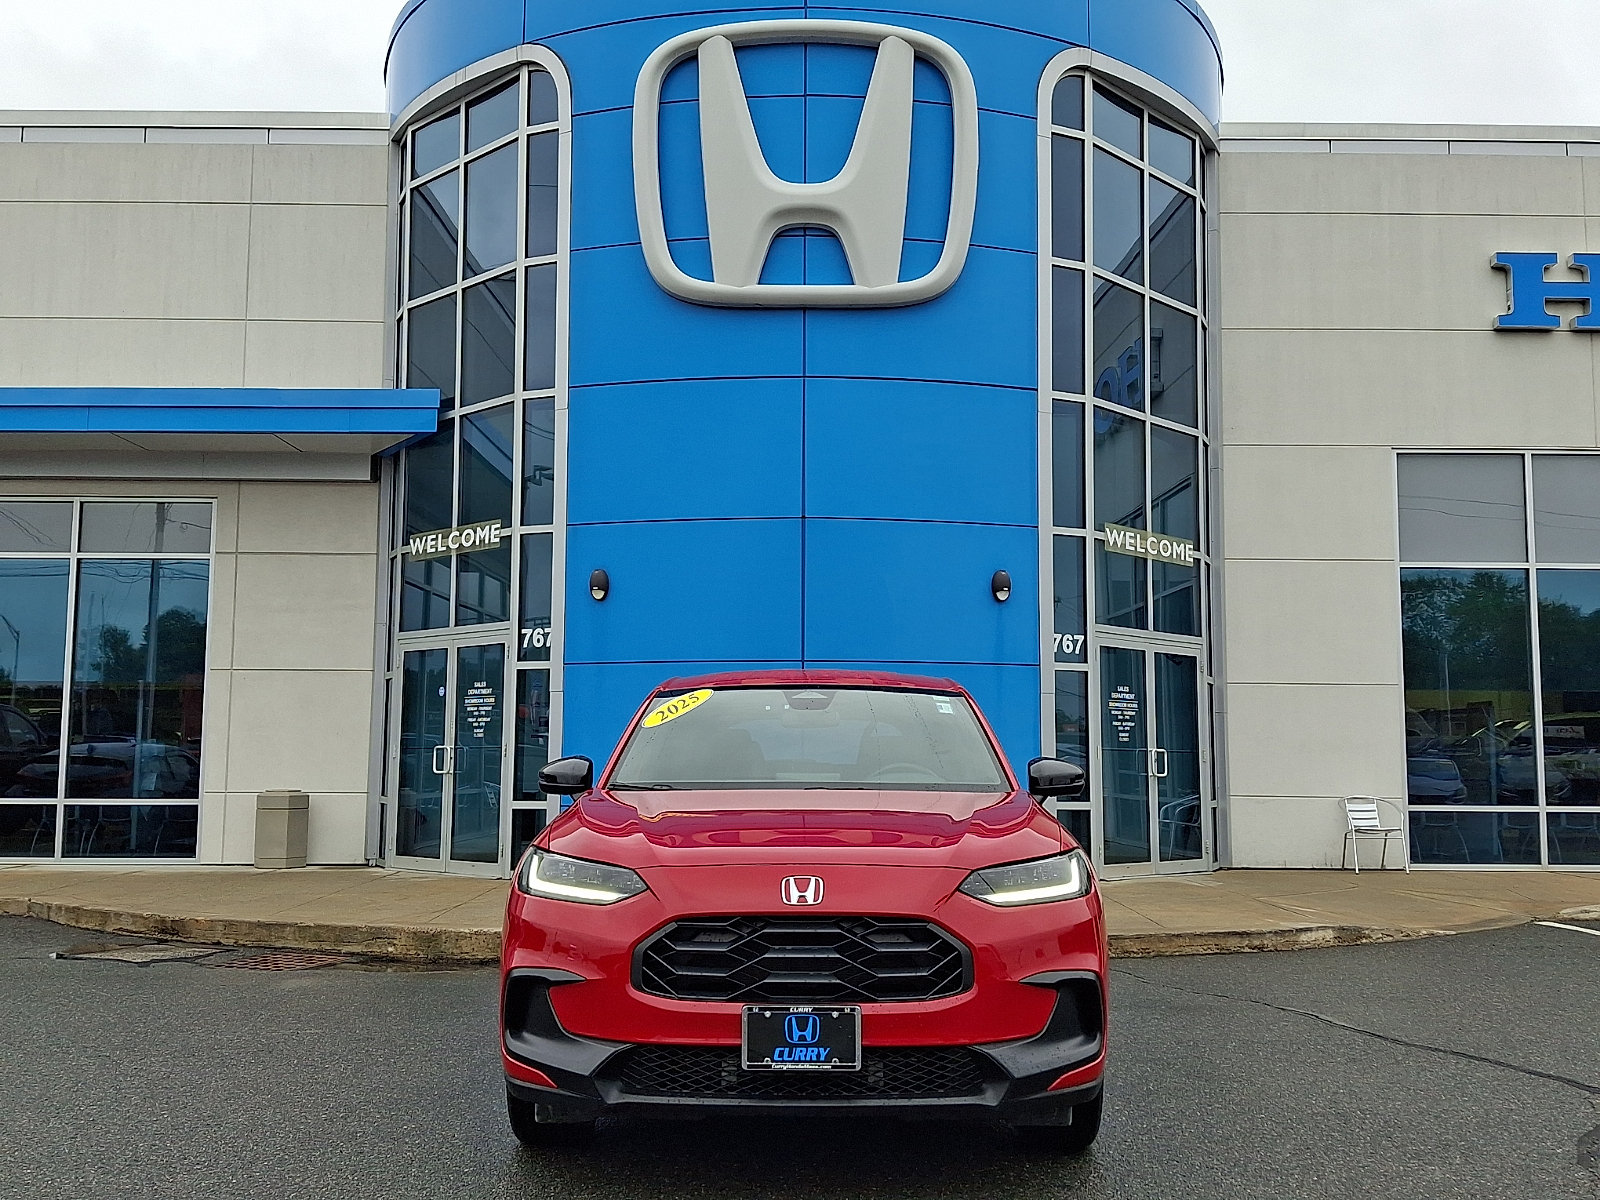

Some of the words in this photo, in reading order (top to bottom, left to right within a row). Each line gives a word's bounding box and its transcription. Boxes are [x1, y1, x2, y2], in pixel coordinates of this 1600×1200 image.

[409, 523, 501, 556] WELCOME
[1105, 527, 1194, 562] WELCOME
[521, 627, 552, 648] 767
[1053, 633, 1085, 655] 767
[656, 693, 700, 722] 2025
[774, 1047, 830, 1061] CURRY
